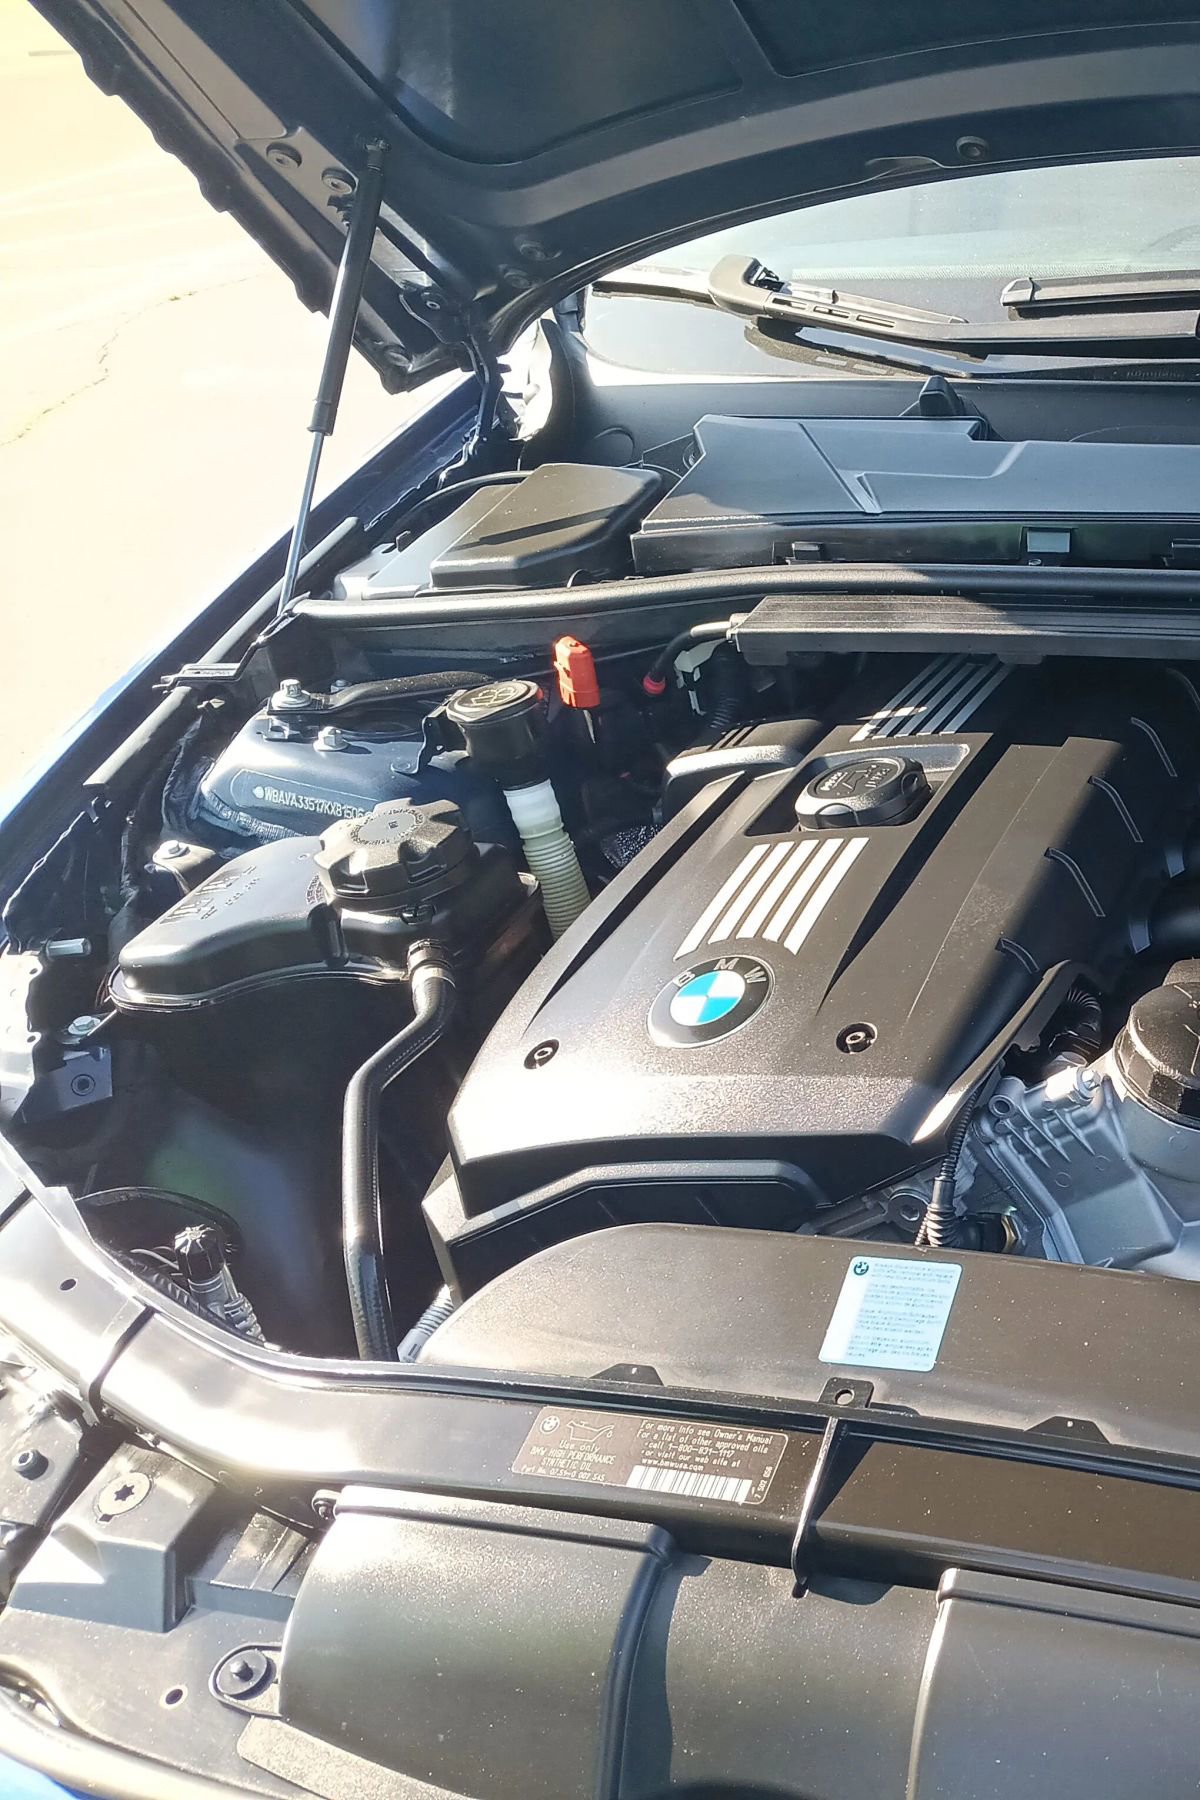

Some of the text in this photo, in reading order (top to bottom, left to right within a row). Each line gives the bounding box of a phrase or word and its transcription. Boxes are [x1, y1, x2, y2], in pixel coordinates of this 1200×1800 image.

[673, 957, 767, 987] BMW
[636, 1429, 650, 1438] For
[691, 1437, 712, 1446] other
[715, 1441, 749, 1452] approved
[641, 1420, 654, 1429] For
[714, 1429, 743, 1441] Owner's
[746, 1433, 774, 1444] Manual
[559, 1439, 600, 1453] Use only
[541, 1457, 592, 1472] SYNTHETIC OIL
[567, 1450, 616, 1465] PERFORMANCE
